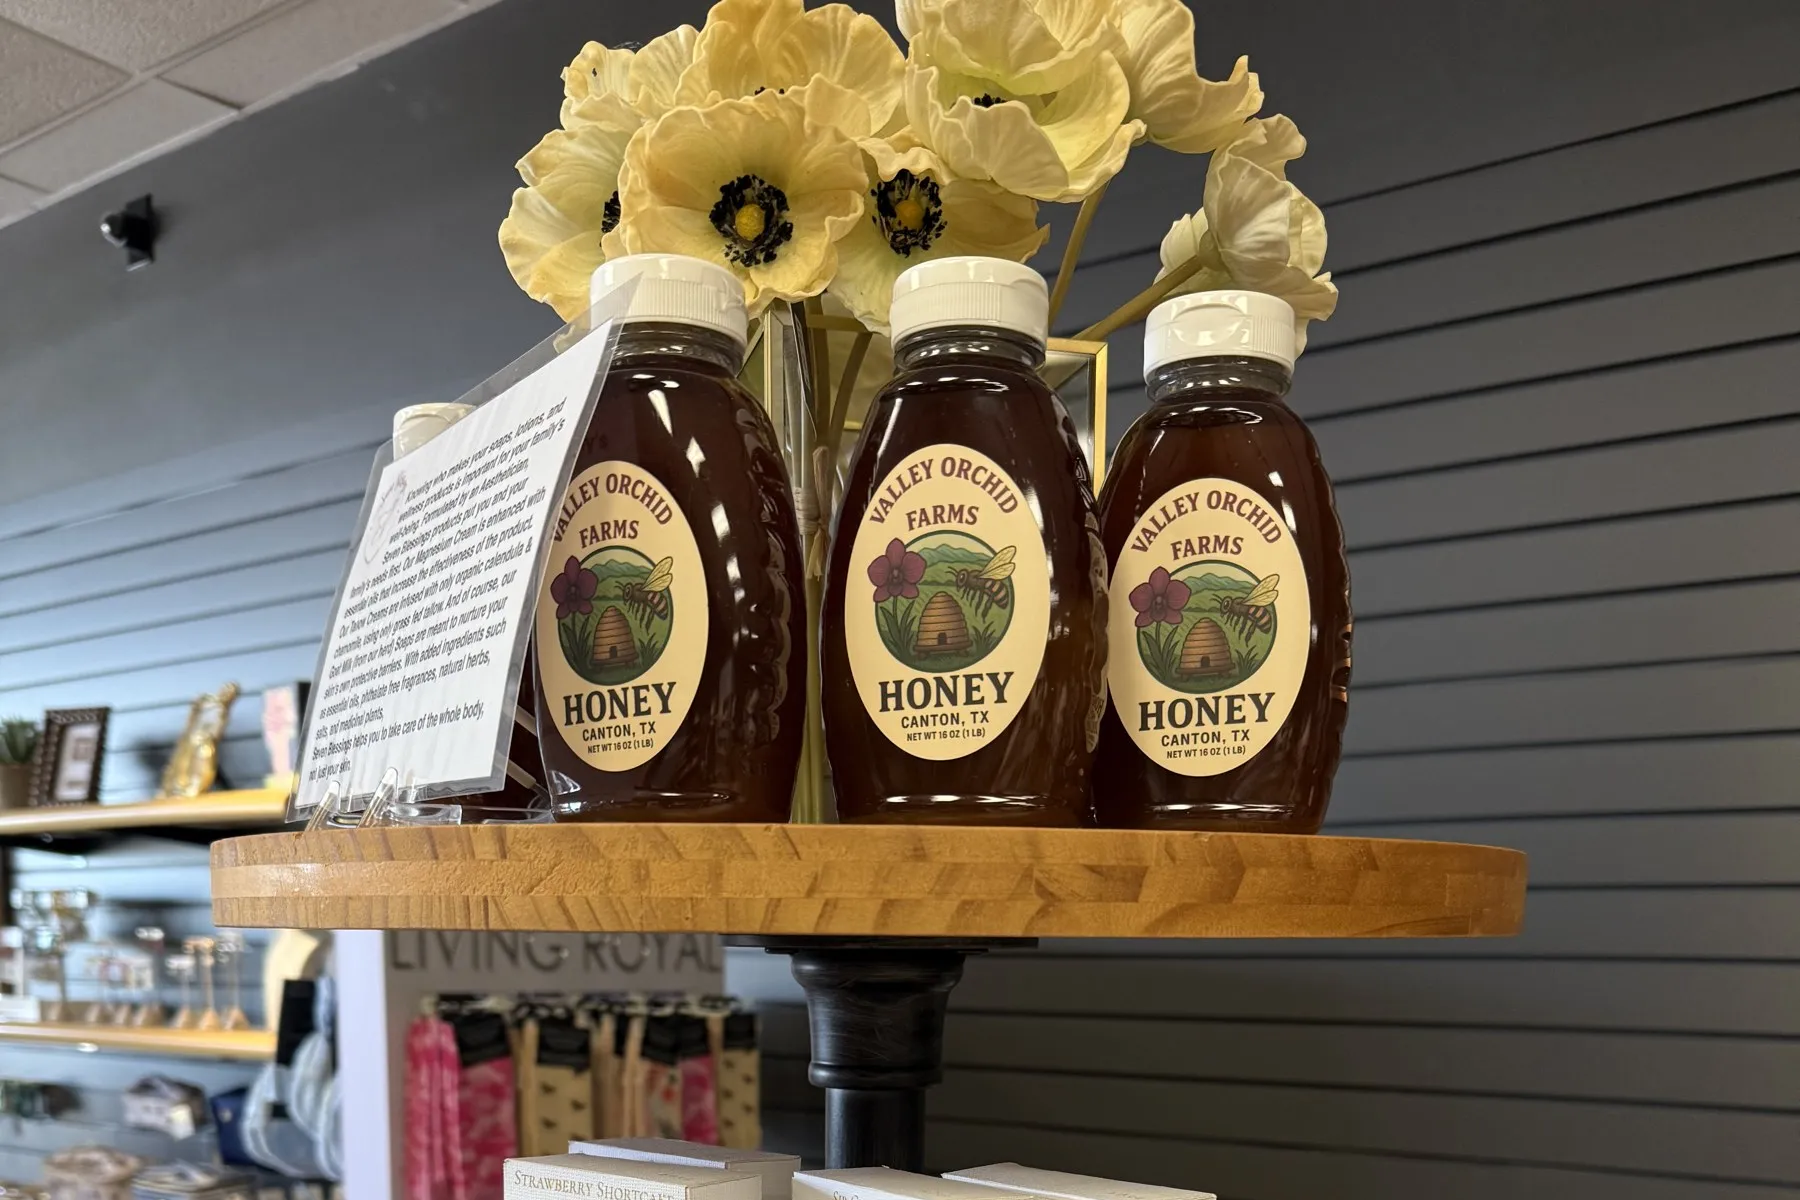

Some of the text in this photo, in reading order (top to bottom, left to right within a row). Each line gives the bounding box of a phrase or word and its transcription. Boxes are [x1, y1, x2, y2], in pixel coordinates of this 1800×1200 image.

[433, 470, 447, 486] who
[447, 457, 470, 478] makes
[469, 446, 488, 467] your
[488, 432, 512, 454] soaps,
[515, 413, 544, 438] lotions,
[547, 397, 567, 419] and
[870, 457, 1018, 525] VALLEY ORCHID
[553, 474, 673, 543] VALLEY ORCHID
[906, 504, 979, 531] FARMS
[1131, 490, 1282, 554] VALLEY ORCHID
[579, 520, 639, 548] FARMS
[1170, 535, 1243, 561] FARMS
[563, 682, 676, 726] HONEY
[879, 671, 1014, 712] HONEY
[901, 710, 989, 730] CANTON, TX
[1138, 692, 1275, 732] HONEY
[312, 700, 484, 760] Seven Blessings helps you to take care of the whole body,
[582, 722, 656, 741] CANTON, TX
[907, 727, 985, 741] NET WT 16 OZ (1 LB)
[1161, 729, 1249, 747] CANTON, TX
[588, 738, 653, 754] NET WT 16 OZ (1 LB)
[1166, 746, 1246, 759] NET WT 16 OZ (1 LB)
[390, 932, 722, 973] LIVING ROYAL
[514, 1170, 594, 1197] STRAWBERRY
